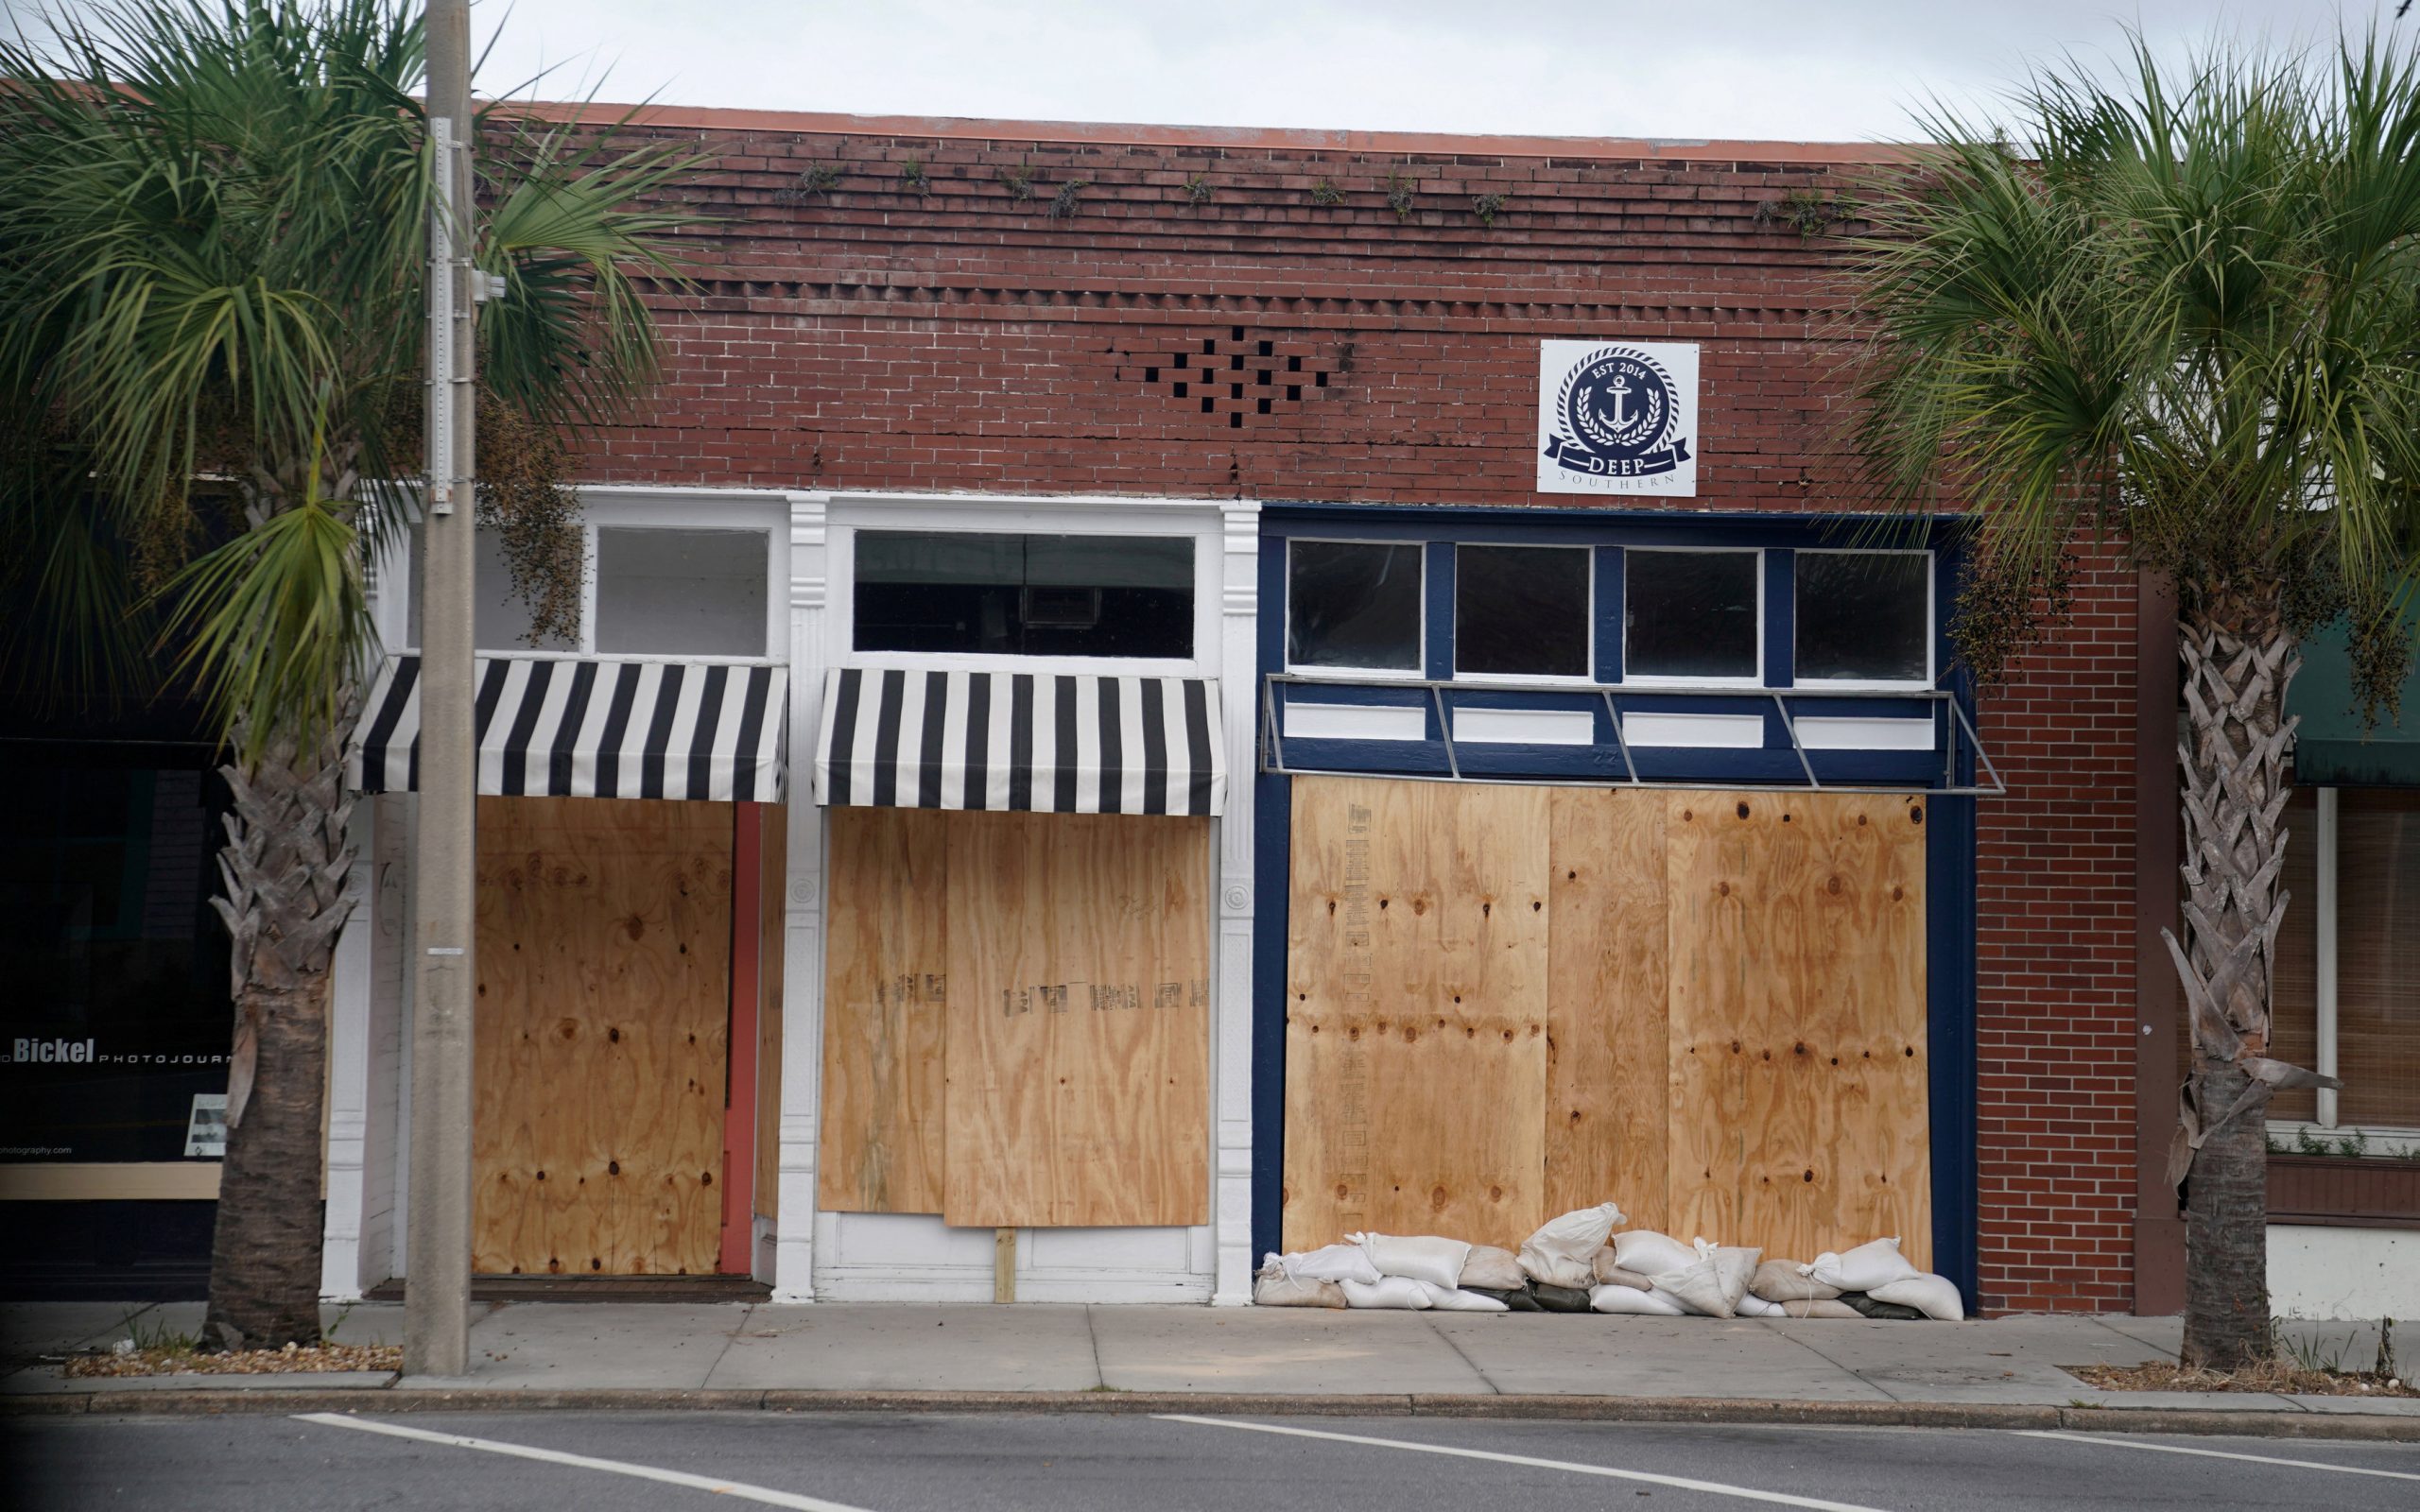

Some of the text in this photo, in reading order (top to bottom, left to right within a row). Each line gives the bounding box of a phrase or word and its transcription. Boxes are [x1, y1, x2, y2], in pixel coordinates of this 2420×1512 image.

[1592, 363, 1648, 380] EST 2014
[1588, 456, 1644, 475] DEEP
[1558, 471, 1675, 490] SOUTHERN
[13, 1039, 95, 1063] Bickel
